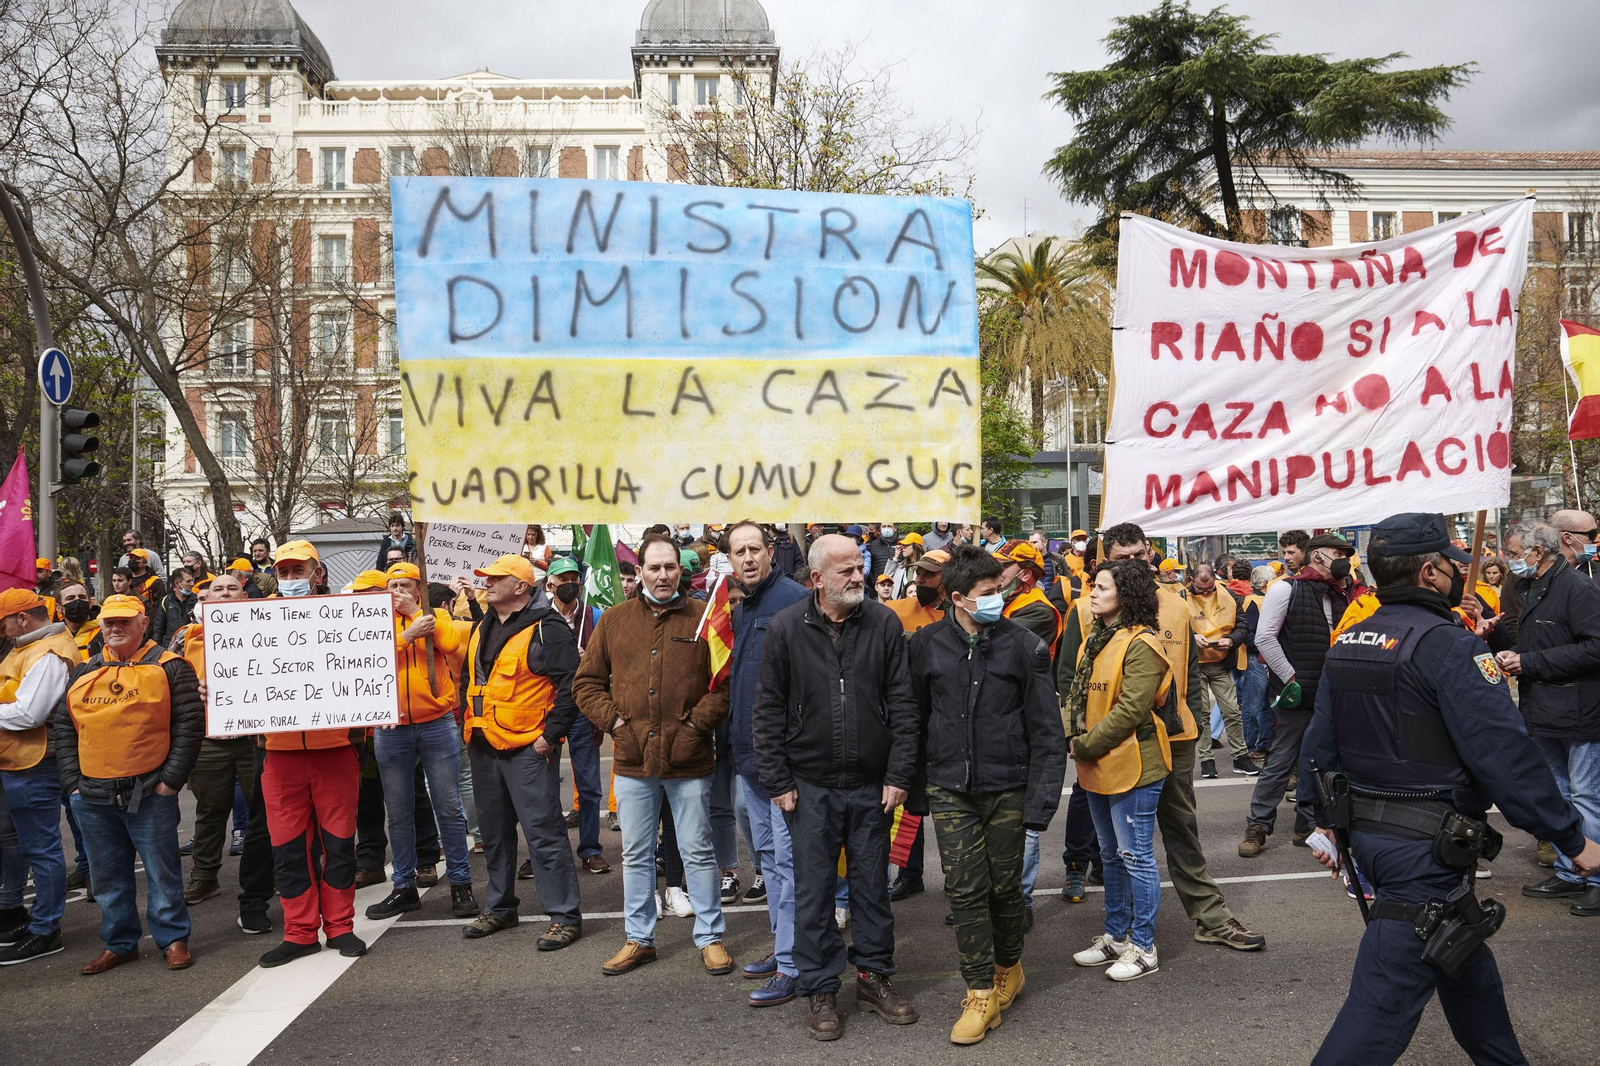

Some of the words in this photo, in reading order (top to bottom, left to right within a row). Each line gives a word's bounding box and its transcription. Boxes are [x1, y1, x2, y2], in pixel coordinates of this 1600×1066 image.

[417, 186, 945, 271] MINISTRA
[1169, 246, 1427, 290] MONTAÑA
[1453, 227, 1506, 268] DE
[446, 266, 957, 344] DIMISION
[1151, 313, 1324, 362] RIAÑO
[1347, 317, 1390, 358] SI
[1411, 310, 1445, 337] A
[1466, 288, 1513, 327] LA
[402, 370, 561, 428] VIVA
[622, 366, 716, 417] LA
[763, 367, 973, 416] CAZA
[1143, 400, 1291, 439] CAZA
[1315, 373, 1390, 416] NO
[1421, 365, 1451, 406] A
[1470, 360, 1515, 401] LA
[1144, 421, 1512, 510] MANIPULACIÓ
[409, 464, 642, 506] CUADRILLA
[681, 455, 976, 502] CUMULGUS
[432, 523, 486, 538] DISFRUTANDO
[492, 530, 504, 540] CON
[509, 534, 522, 543] MIS
[457, 541, 472, 552] ESOS
[426, 554, 438, 565] QUE
[444, 558, 456, 568] NOS
[462, 560, 472, 570] DA
[211, 609, 240, 623] QUE
[250, 607, 271, 621] MÁS
[319, 605, 344, 619] QUE
[352, 602, 388, 618] PASAR
[213, 633, 244, 650] PARA
[252, 632, 278, 648] QUE
[288, 631, 307, 645] OS
[348, 627, 392, 642] CUENTA
[1334, 631, 1387, 646] POLICIA
[214, 662, 238, 678] QUE
[248, 659, 263, 675] EL
[271, 657, 315, 674] SECTOR
[216, 691, 233, 707] ES
[243, 689, 258, 703] LA
[265, 687, 297, 701] BASE
[304, 684, 323, 701] DE
[332, 681, 349, 698] UN
[270, 715, 300, 727] RURAL
[351, 712, 362, 722] LA
[365, 711, 391, 721] CAZA
